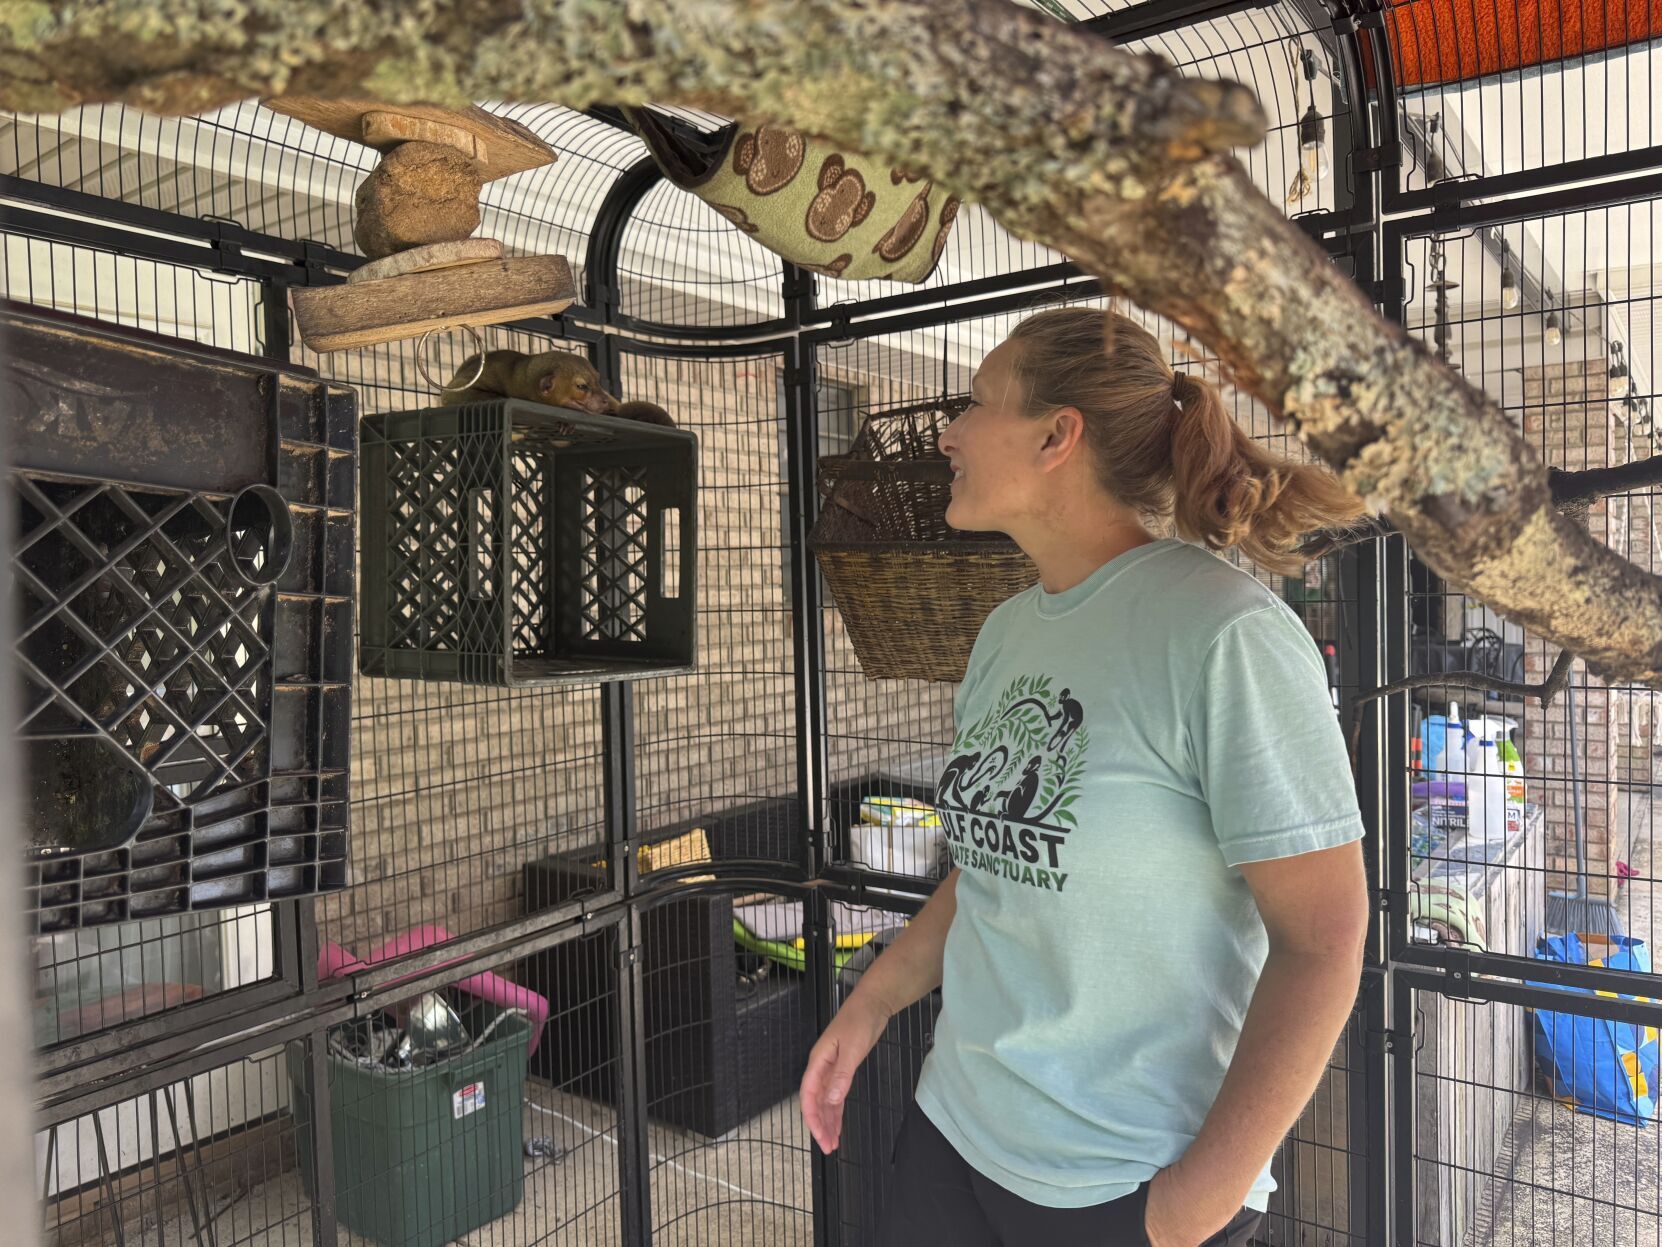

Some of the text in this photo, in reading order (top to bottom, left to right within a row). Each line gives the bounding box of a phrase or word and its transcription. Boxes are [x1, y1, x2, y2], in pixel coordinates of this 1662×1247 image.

[938, 811, 1065, 869] ULF COAST
[951, 842, 1069, 893] ATE SANCTUARY
